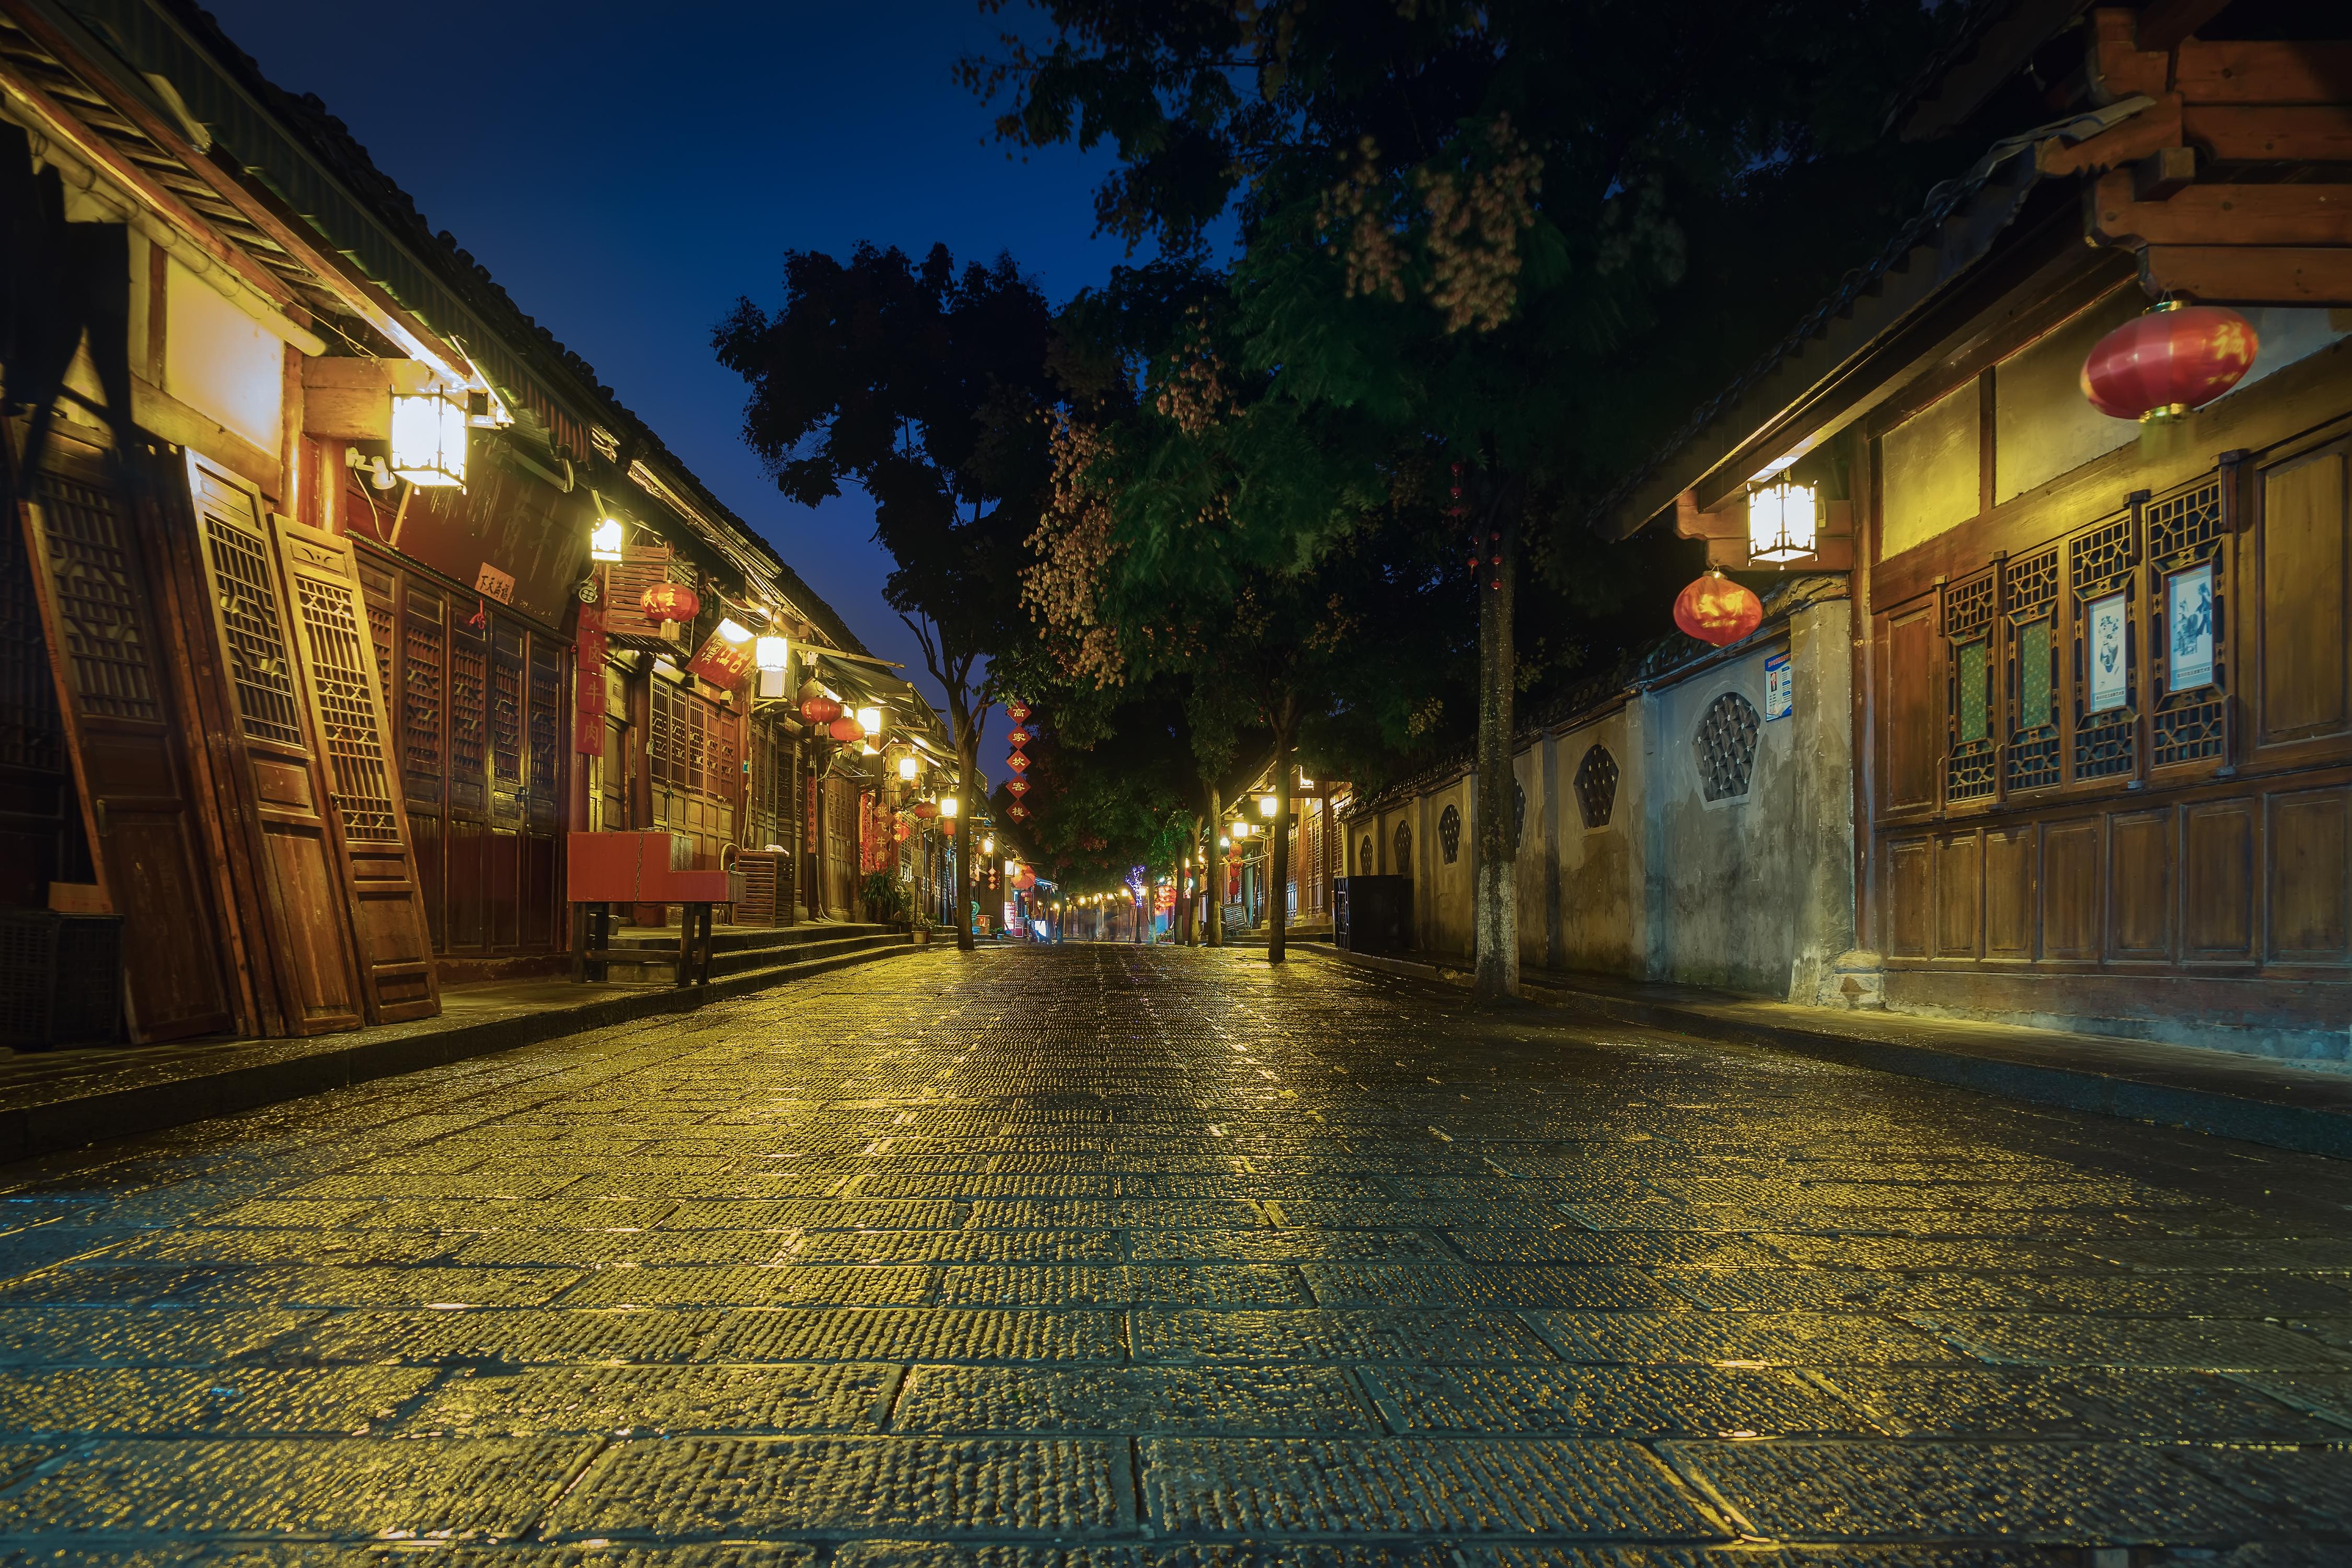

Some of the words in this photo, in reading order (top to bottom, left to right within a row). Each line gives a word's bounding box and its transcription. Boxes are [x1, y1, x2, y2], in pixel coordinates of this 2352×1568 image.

[643, 589, 677, 608] 民主
[1012, 708, 1026, 816] 高家坎客栈
[876, 806, 887, 862] 张飞牛肉
